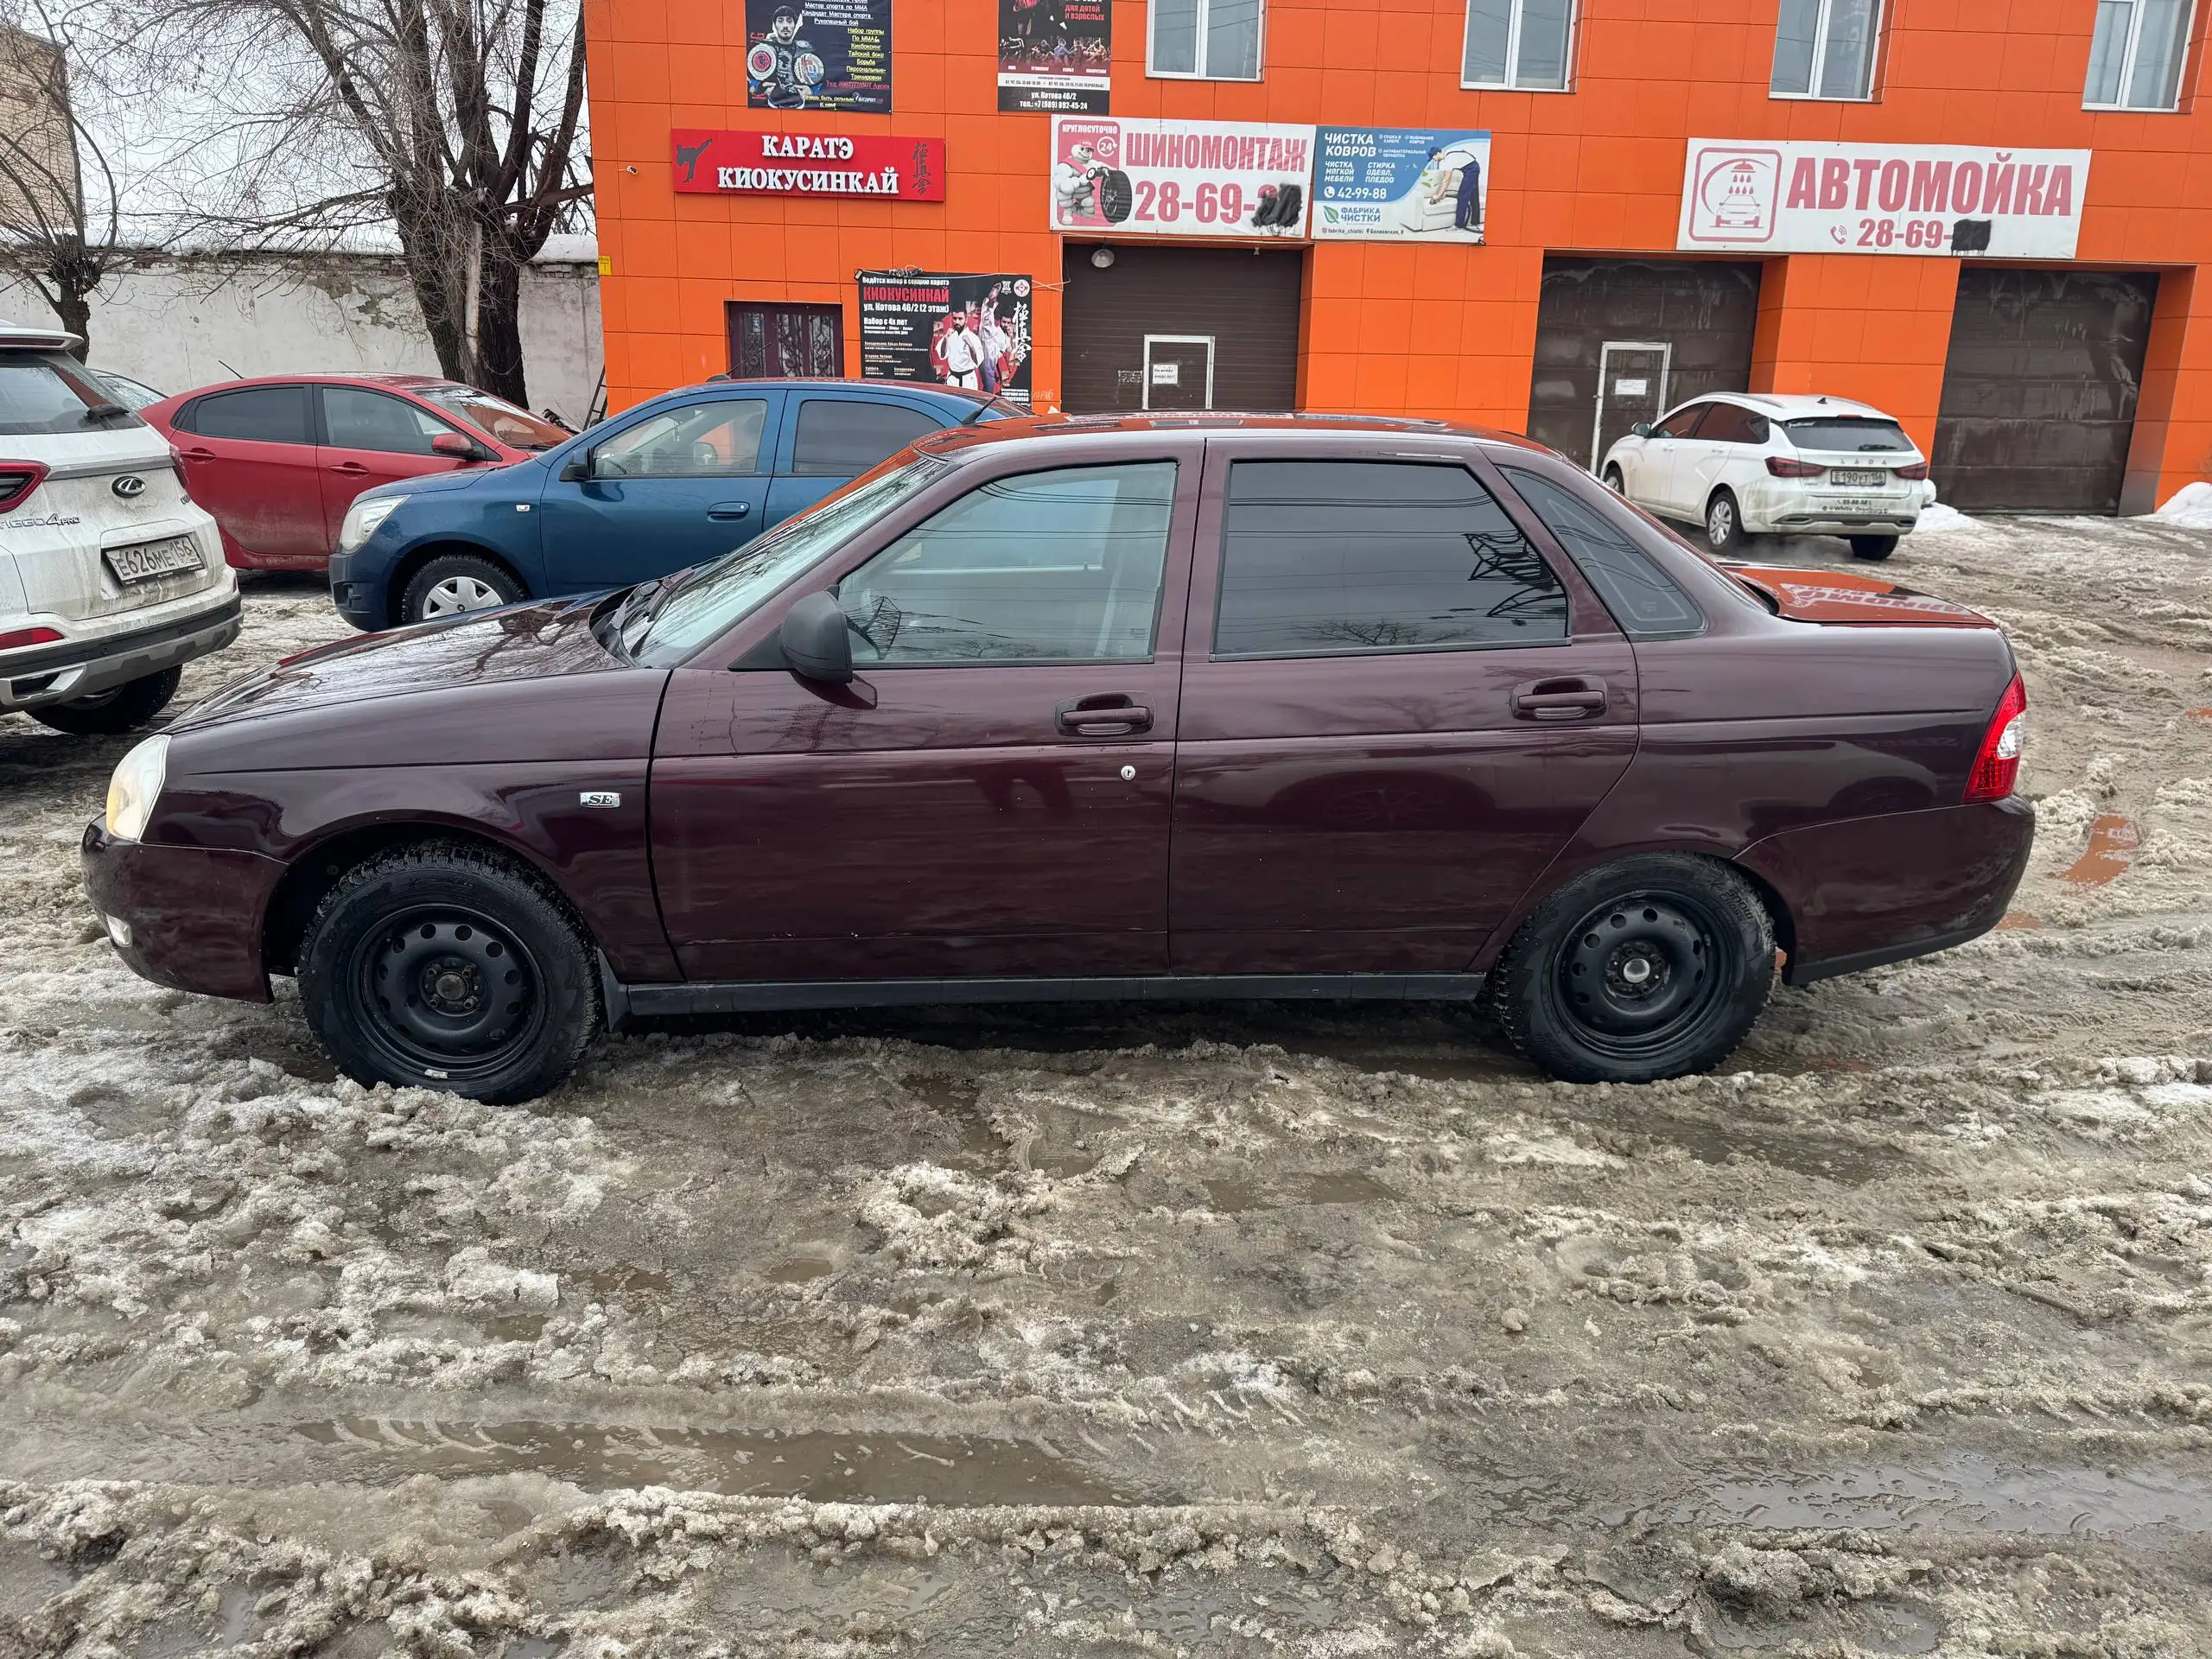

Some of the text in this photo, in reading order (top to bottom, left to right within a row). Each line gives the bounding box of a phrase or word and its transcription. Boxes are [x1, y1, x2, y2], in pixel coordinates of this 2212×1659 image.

[1062, 124, 1118, 135] КРУГЛОСУТОЧНО
[1325, 133, 1374, 145] ЧИСТКА
[761, 135, 855, 159] КАРАТЭ
[1126, 132, 1308, 173] ШИНОМОНТАЖ
[1325, 145, 1376, 156] КОВРОВ
[717, 166, 899, 194] КИОКУСИНКАЙ
[1786, 151, 2073, 216] АВТОМОЙКА
[1338, 188, 1387, 199] 42-99-88
[863, 287, 950, 302] КИОКУСИНКАЙ
[875, 302, 900, 311] Котова
[588, 794, 613, 805] SE
